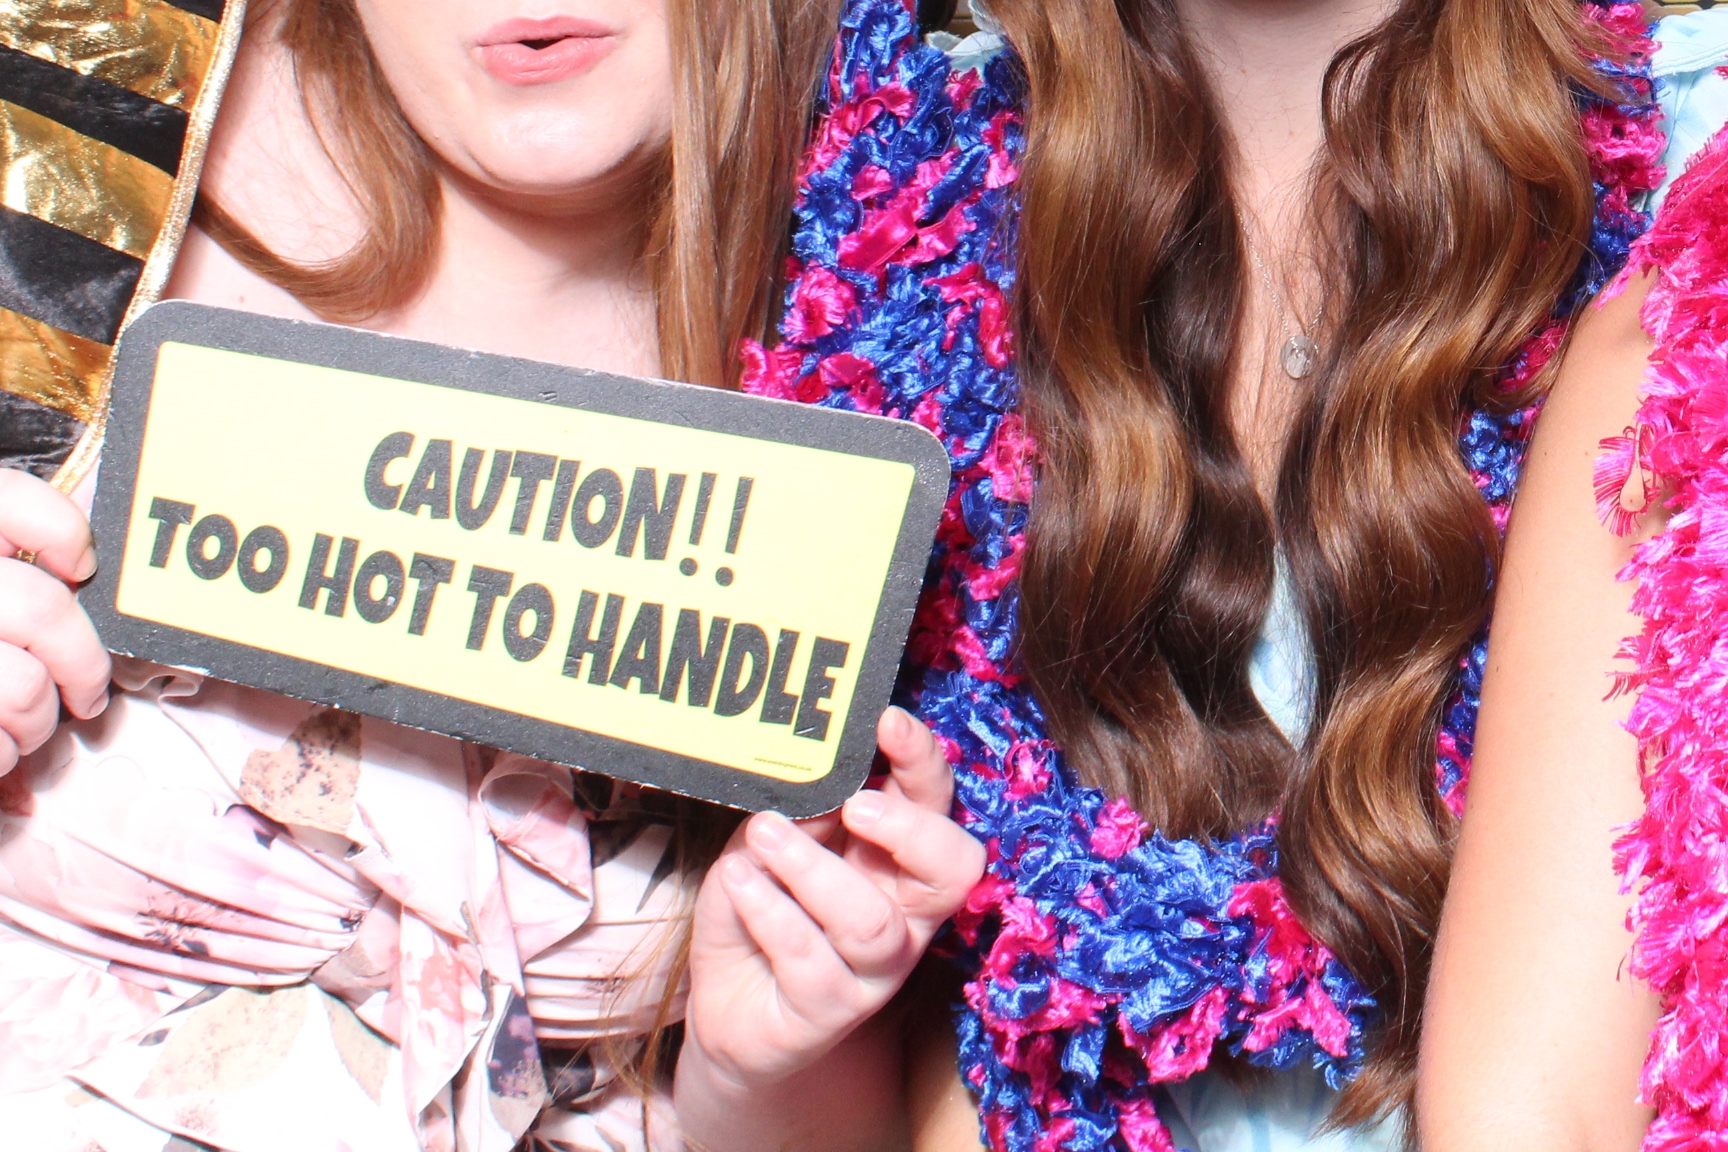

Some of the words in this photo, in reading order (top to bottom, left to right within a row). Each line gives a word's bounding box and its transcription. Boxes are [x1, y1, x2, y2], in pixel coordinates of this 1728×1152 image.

[364, 432, 754, 588] CAUTION!!
[148, 497, 290, 594] TOO
[298, 533, 455, 636] HOT
[466, 565, 555, 662] TO
[561, 590, 850, 742] HANDLE
